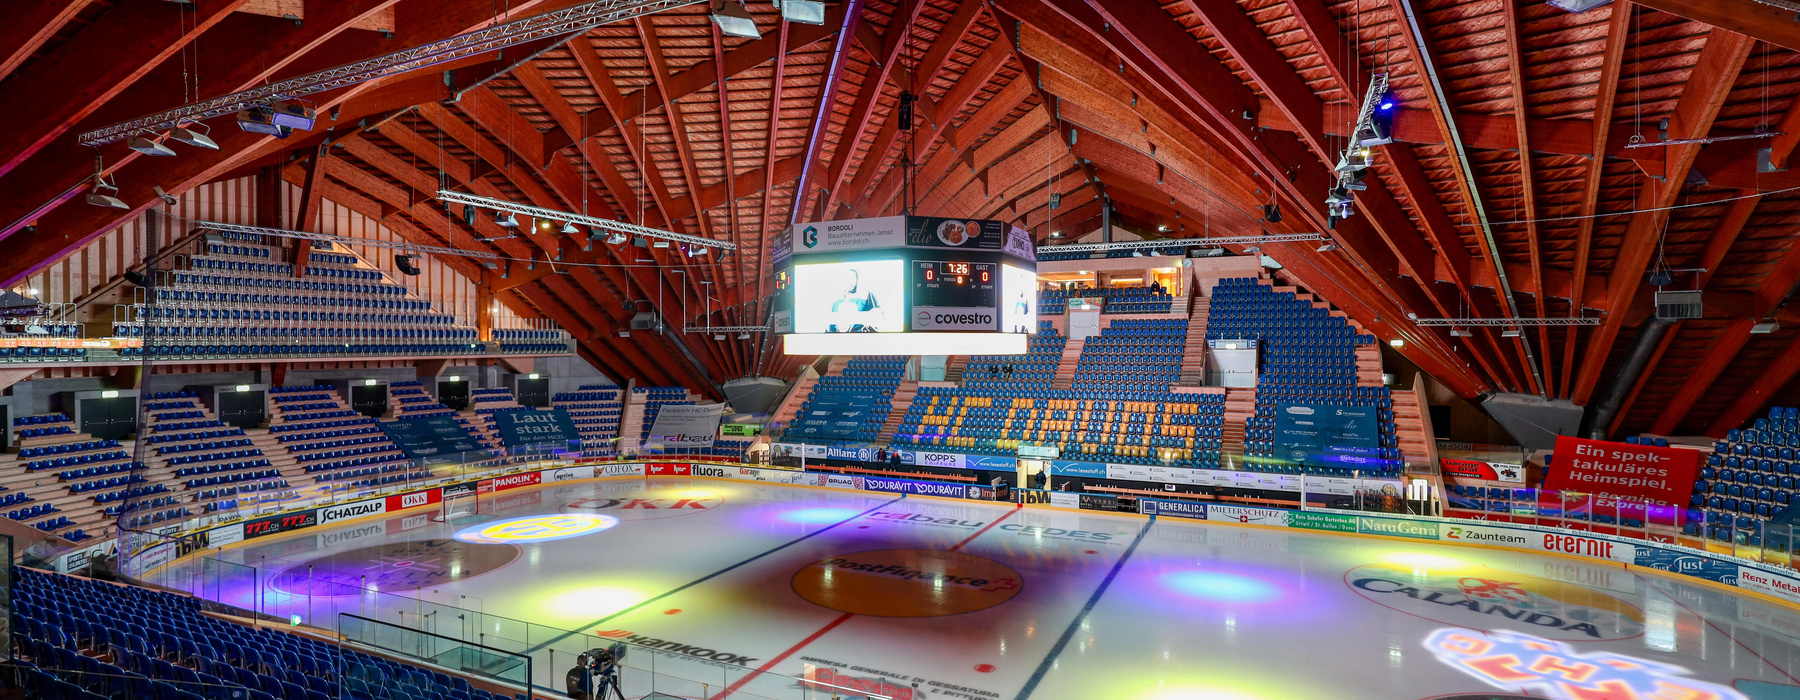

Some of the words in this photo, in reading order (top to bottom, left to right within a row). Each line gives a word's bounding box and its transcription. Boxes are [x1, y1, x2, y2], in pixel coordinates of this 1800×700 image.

[828, 231, 876, 239] Bauunternehmen
[828, 238, 870, 246] www.bordoli.ch
[948, 263, 968, 274] 7:26
[926, 270, 933, 280] 0
[982, 271, 988, 282] 0
[935, 312, 992, 325] covestro
[510, 412, 557, 424] Laut
[516, 423, 562, 434] stark
[827, 448, 857, 459] Allianz
[1576, 444, 1605, 457] Ein
[1611, 450, 1671, 463] spek-
[605, 464, 634, 474] COFOX
[979, 461, 1015, 469] www.lesestoff.ch
[1446, 460, 1480, 468] Garage
[1572, 458, 1668, 477] takuläres
[740, 467, 760, 477] Garage
[1066, 467, 1106, 475] www.lesestoff.ch
[496, 474, 531, 487] PANOLIN
[878, 480, 911, 492] DURAVIT
[1569, 470, 1673, 491] Heimspiel.
[927, 484, 962, 496] DURAVIT
[403, 492, 425, 505] ÖKK
[568, 498, 719, 509] ÖKK
[321, 502, 382, 523] SCHATZALP
[1158, 501, 1204, 513] GENERALICA
[1209, 505, 1280, 518] MIETERSCHUTZ
[246, 520, 279, 534] 777.CH
[282, 514, 315, 528] 777.CH
[1361, 518, 1437, 536] NatuGena
[1449, 517, 1482, 525] ticketmaster
[1488, 521, 1522, 529] ticketmaster
[1000, 523, 1113, 542] CEDES
[1528, 525, 1565, 533] ticketmaster
[1571, 529, 1610, 539] ticketmaster
[1466, 530, 1526, 544] Zaunteam
[1616, 534, 1655, 547] ticketmaster
[1543, 533, 1613, 559] eternit
[1662, 543, 1702, 555] ticketmaster
[67, 553, 84, 564] SPORTS
[1636, 549, 1650, 557] ust
[1709, 553, 1749, 566] ticketmaster
[1677, 559, 1704, 573] Just
[1755, 562, 1796, 576] ticketmaster
[822, 558, 990, 587] PostFinance
[1742, 571, 1768, 585] Renz
[1352, 578, 1602, 639] CALANDA
[626, 634, 759, 667] Hankook
[800, 655, 848, 669] IMPRESA
[850, 664, 910, 681] GENERALE
[927, 680, 1000, 699] GESSATURA
[943, 690, 1000, 700] PITTUR
